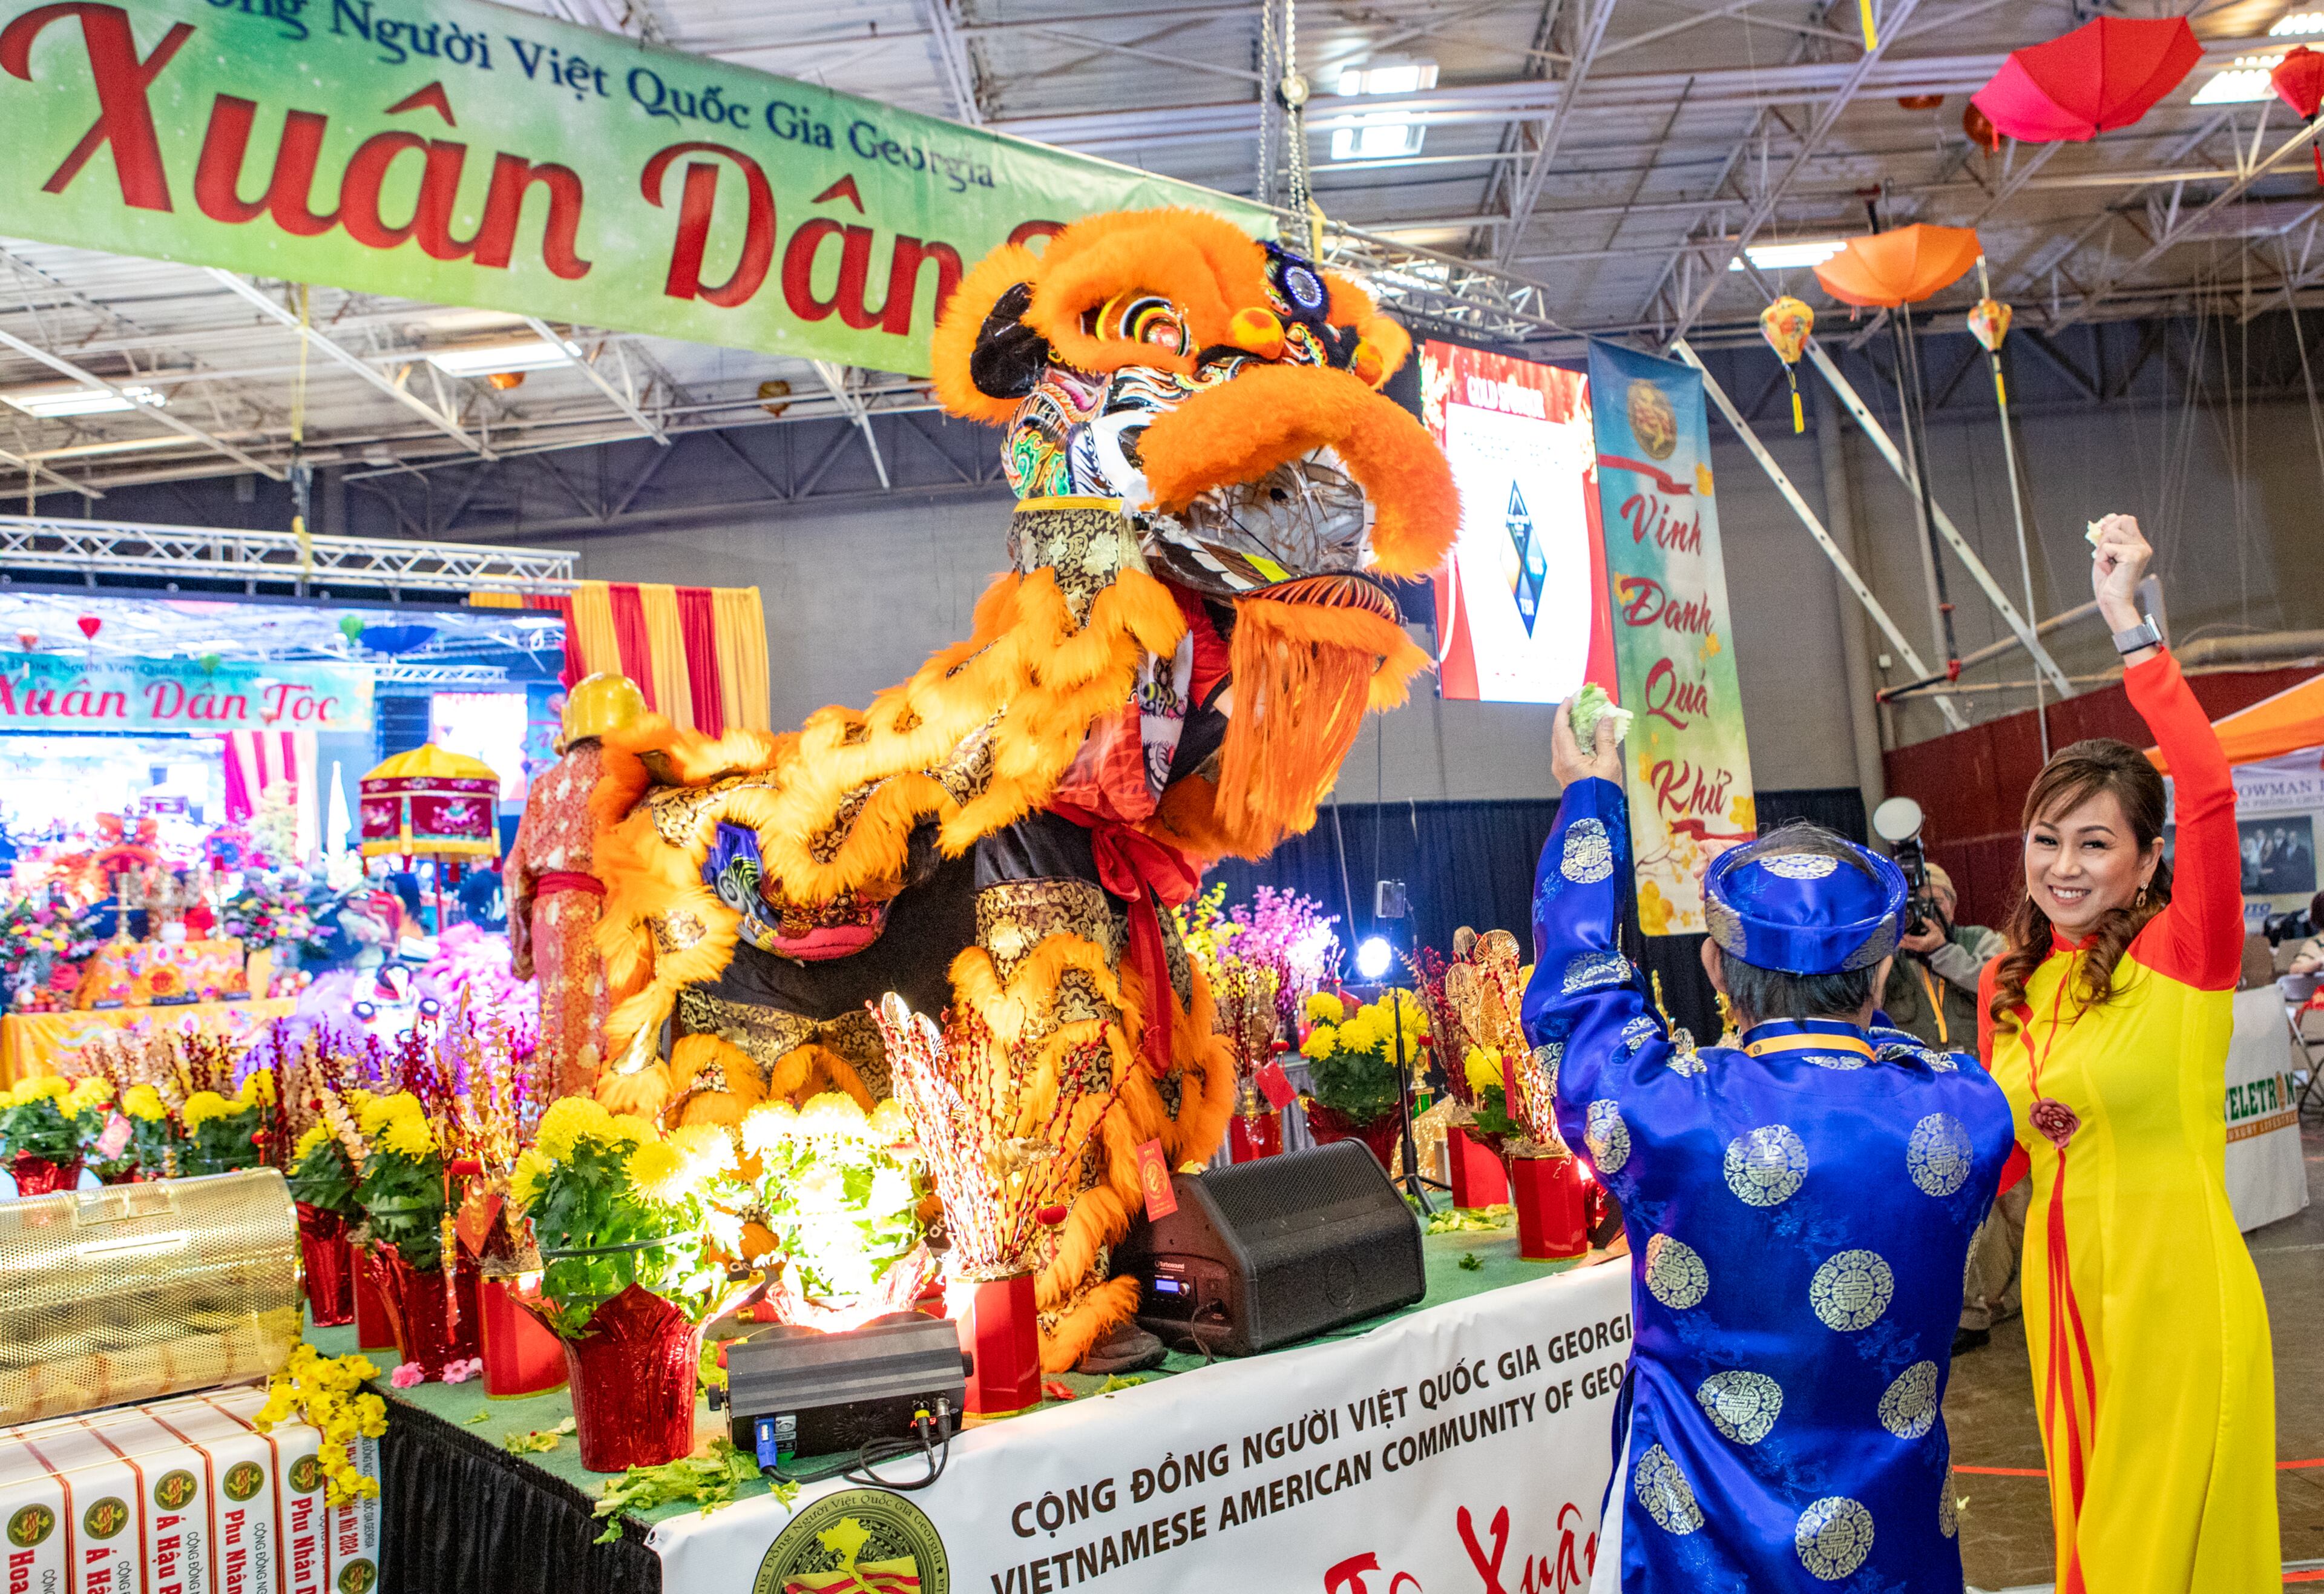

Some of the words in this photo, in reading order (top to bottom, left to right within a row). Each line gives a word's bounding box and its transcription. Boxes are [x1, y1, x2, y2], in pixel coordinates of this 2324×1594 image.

[328, 0, 494, 70] Người
[506, 36, 612, 101] Việt
[626, 67, 752, 130] Quốc
[765, 100, 834, 150] Gia
[848, 120, 996, 193] Georgia
[0, 2, 592, 280] Xuân
[640, 141, 963, 336] Dân
[1620, 493, 1702, 556] Vinh
[1644, 657, 1709, 730] Quá
[2238, 779, 2312, 796] OWMAN
[1011, 1478, 1116, 1538] CỘNG
[1130, 1443, 1229, 1504] ĐỒNG
[1242, 1408, 1339, 1469] NGƯỜI
[1347, 1386, 1408, 1432] VIỆT
[1419, 1357, 1490, 1411] QUỐC
[1497, 1344, 1541, 1381] GIA
[1548, 1312, 1632, 1364] GEORGI
[990, 1504, 1207, 1594] VIETNAMESE
[1218, 1450, 1372, 1532] AMERICAN
[1382, 1392, 1536, 1473] COMMUNITY
[1544, 1379, 1574, 1414] OF
[1581, 1361, 1628, 1400] GEO
[156, 1515, 186, 1531] Á
[225, 1509, 245, 1546] Phu
[291, 1497, 313, 1533] Phu
[792, 1504, 829, 1533] Người
[831, 1496, 856, 1508] Việt
[860, 1494, 893, 1505] Quốc
[894, 1501, 913, 1517] Gia
[914, 1515, 942, 1564] Georgia
[187, 1532, 201, 1560] CỘNG
[253, 1522, 268, 1551] CỘNG
[339, 1532, 359, 1556] 2024
[9, 1549, 35, 1594] Hoa
[86, 1547, 117, 1564] Á
[152, 1535, 181, 1579] Hậu
[255, 1552, 271, 1581] ĐỒNG
[293, 1535, 316, 1583] Nhân
[117, 1561, 132, 1592] CỘNG
[188, 1561, 204, 1590] ĐỒNG
